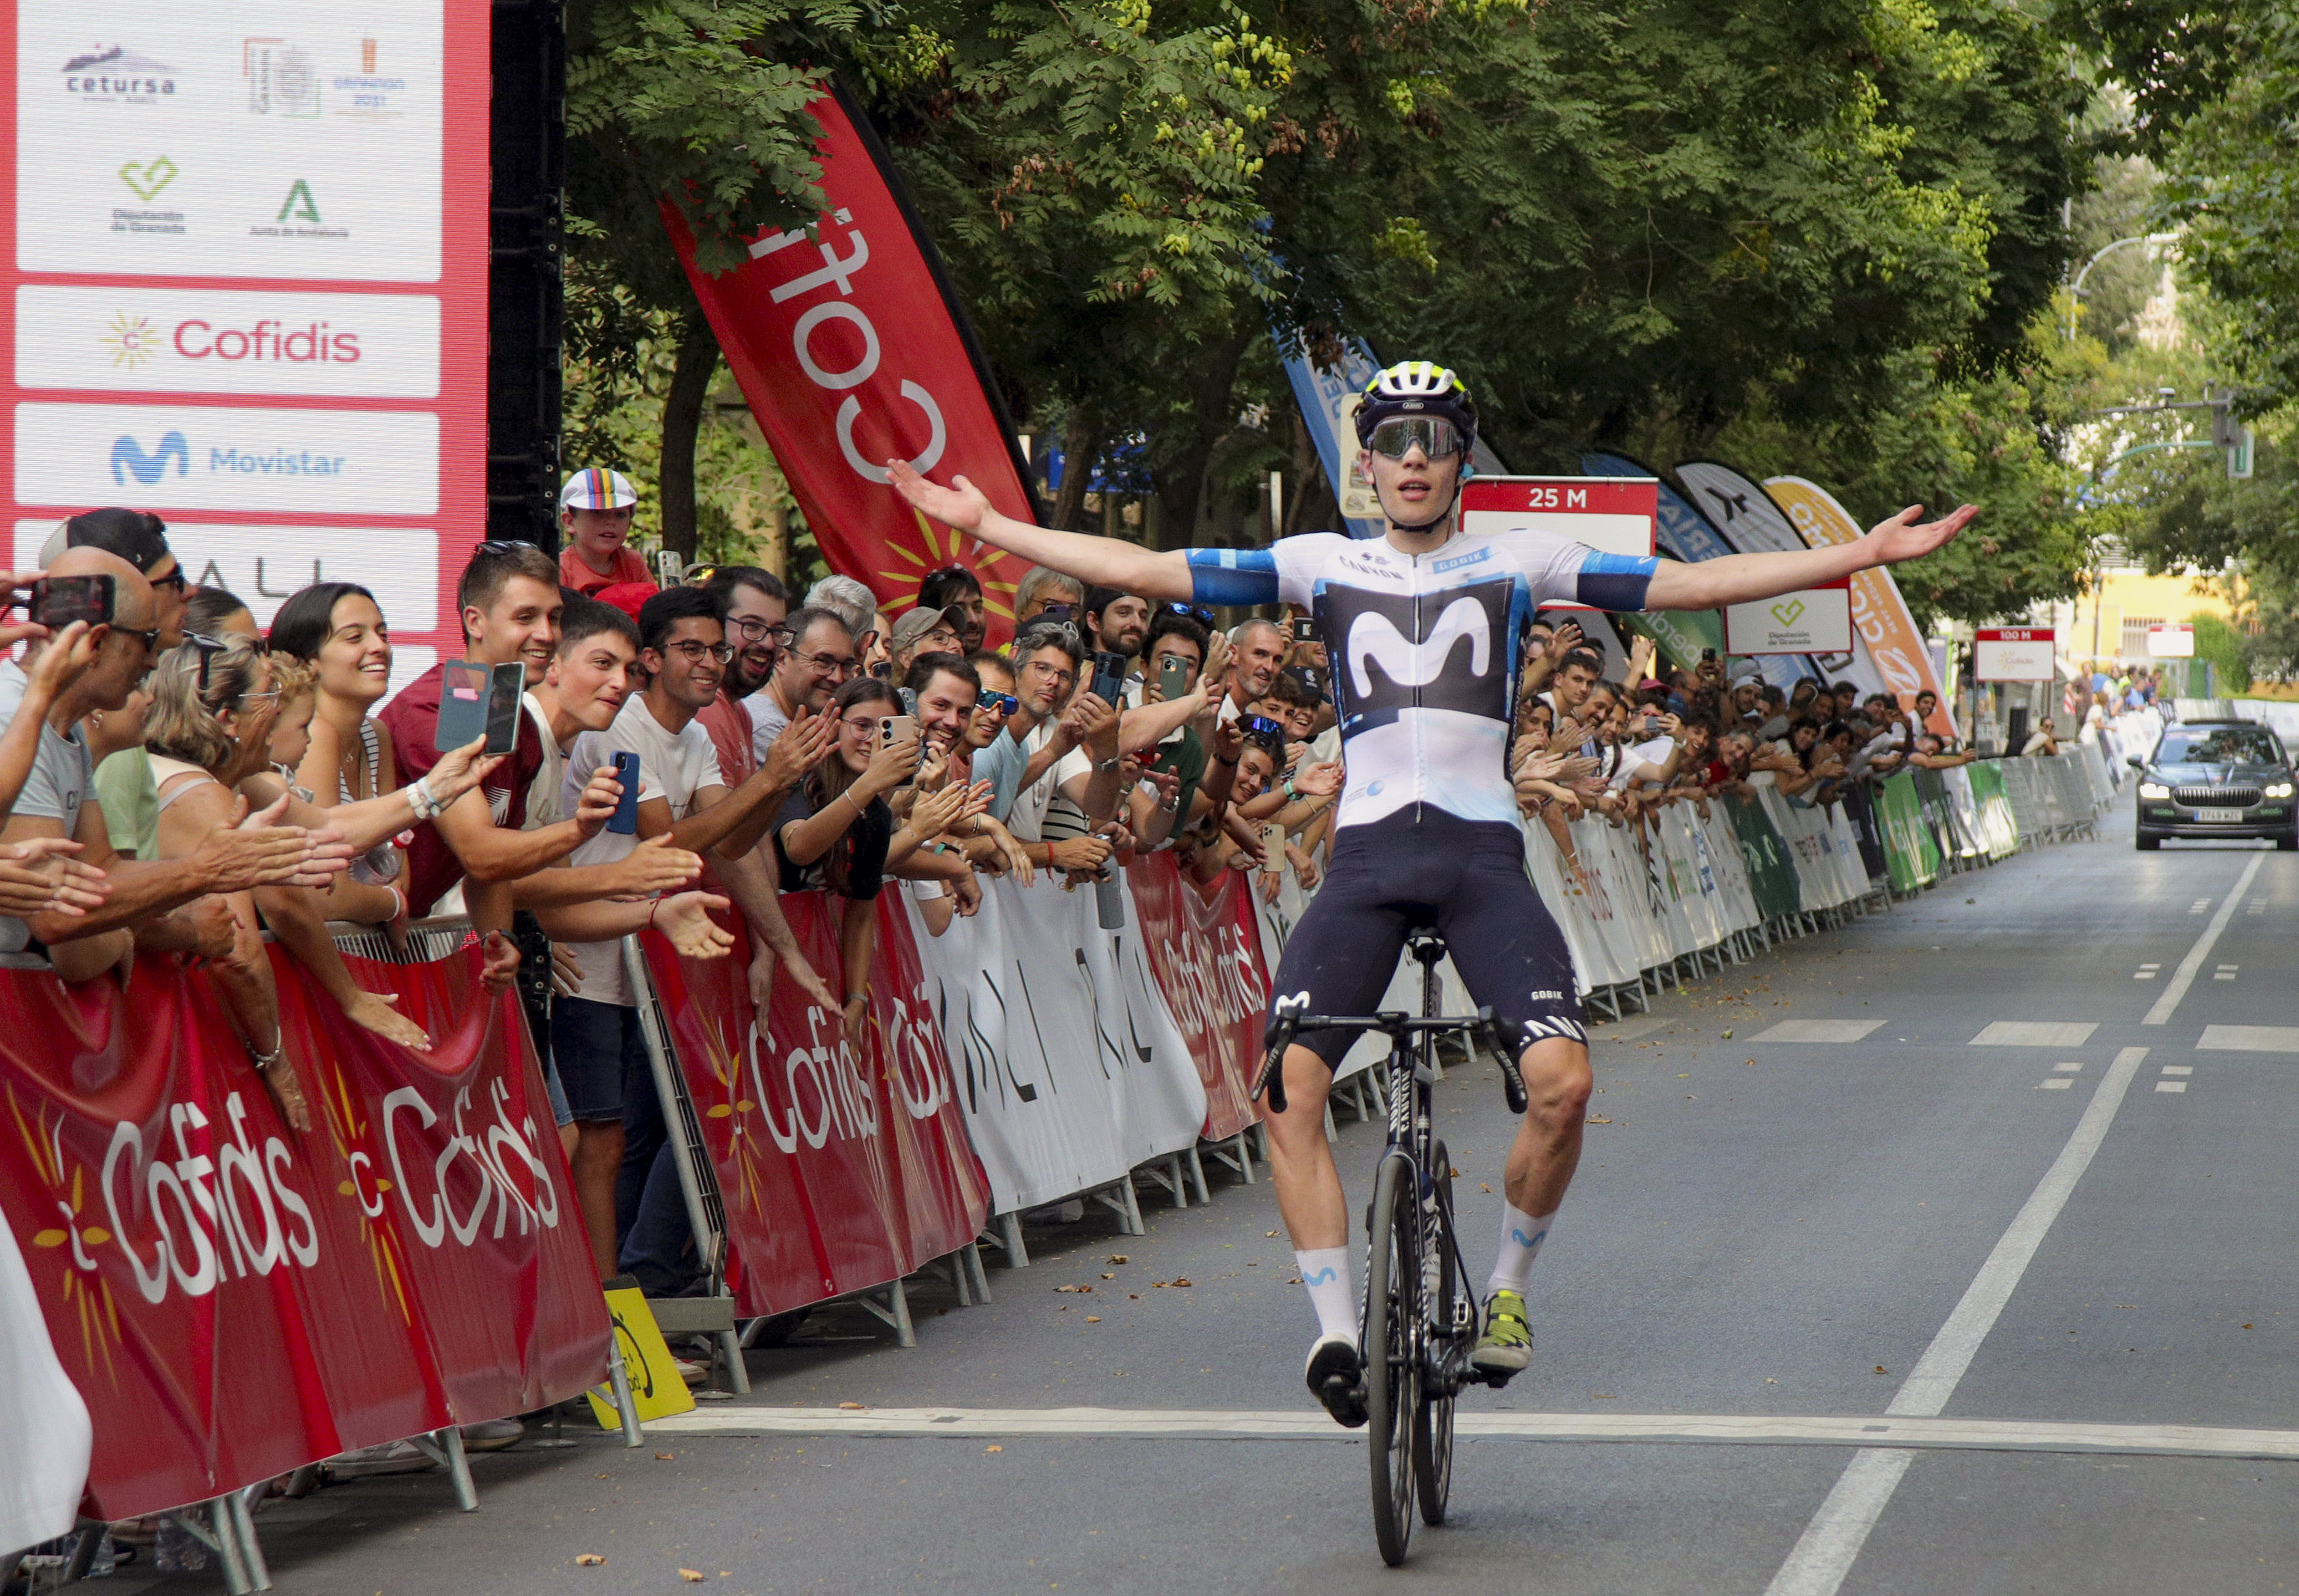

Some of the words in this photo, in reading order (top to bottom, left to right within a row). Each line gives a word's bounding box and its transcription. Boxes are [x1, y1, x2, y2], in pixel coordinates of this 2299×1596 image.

[67, 76, 175, 95] cetursa
[174, 319, 361, 363] Cofidis
[210, 448, 346, 475] Movistar
[1529, 487, 1560, 510] 25
[1566, 488, 1587, 509] M
[1339, 555, 1405, 580] CANYON
[2000, 630, 2020, 640] 100
[2021, 630, 2032, 640] M
[1531, 990, 1564, 1001] GOBIK
[1389, 1066, 1400, 1132] CANYON
[1400, 1069, 1411, 1132] CANYON
